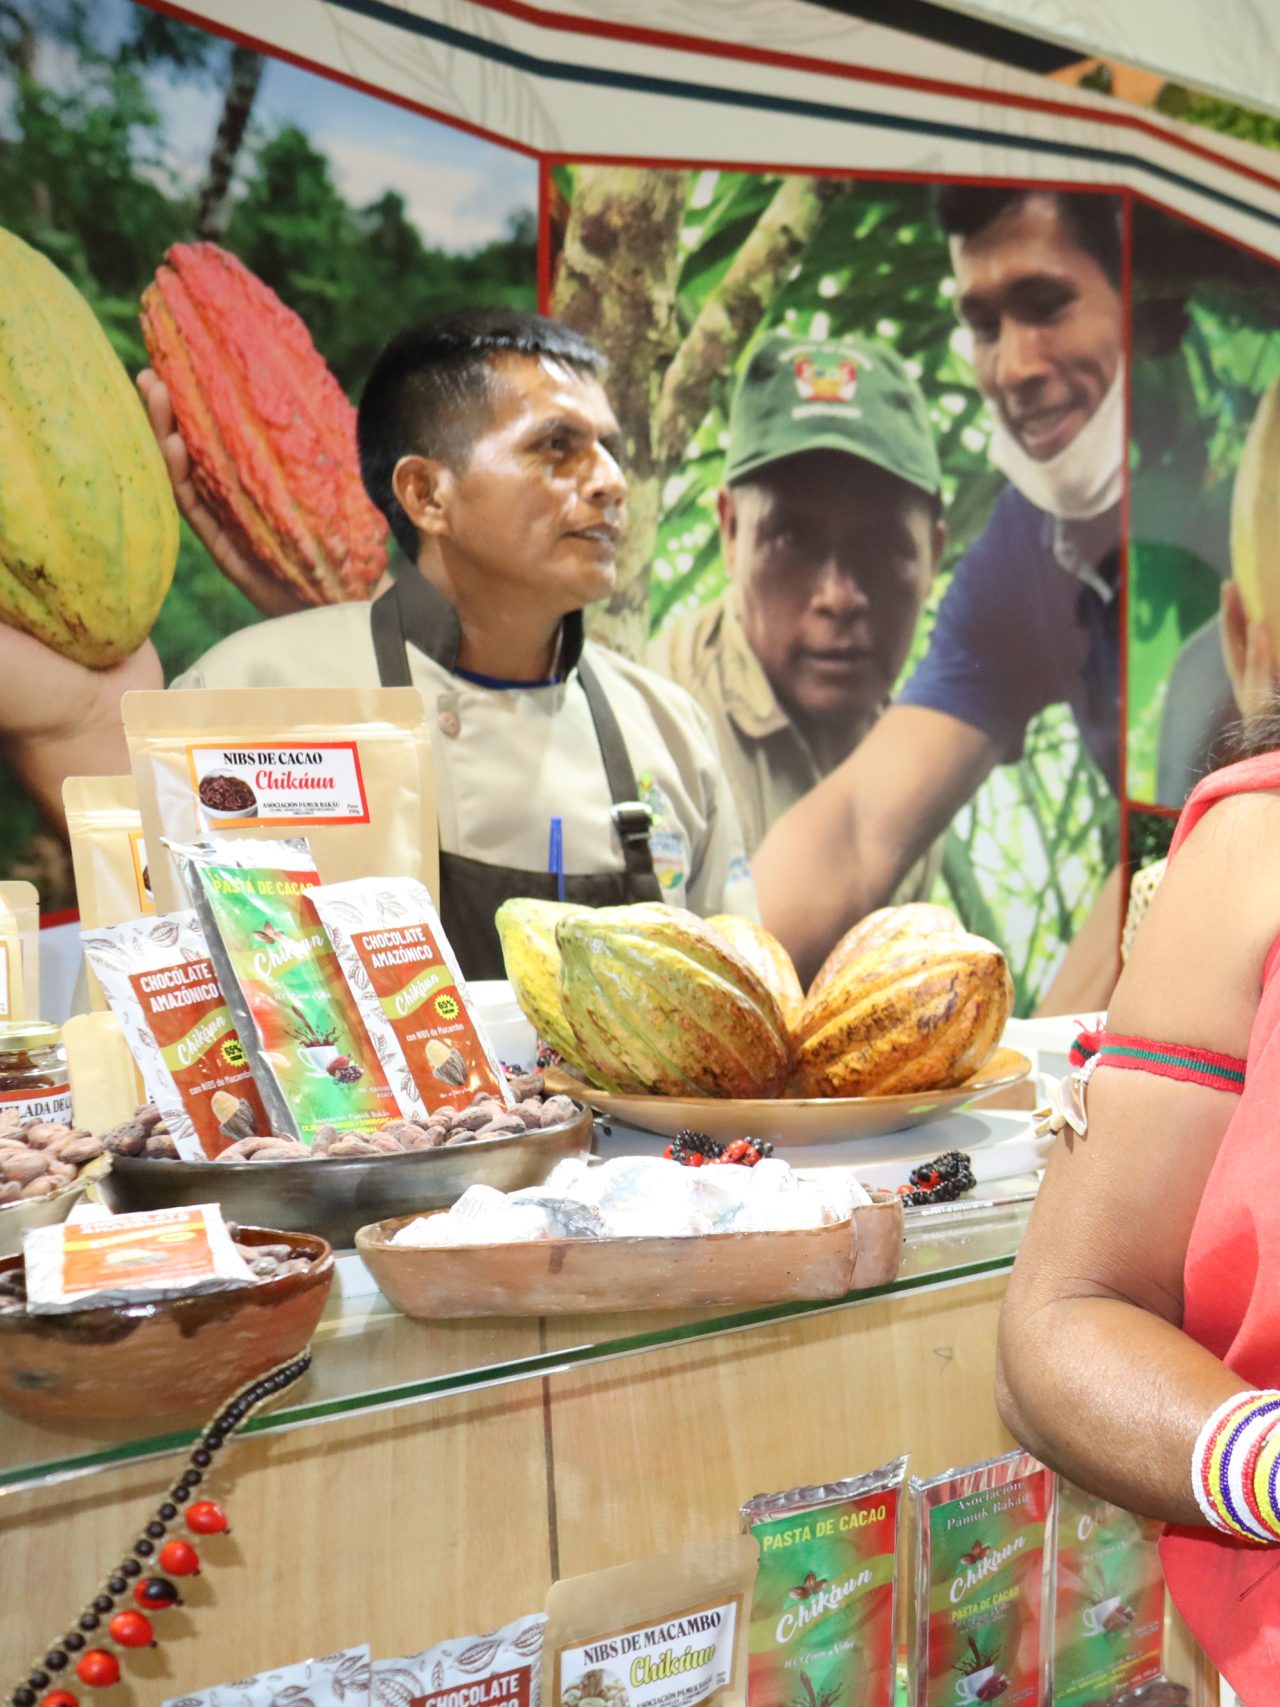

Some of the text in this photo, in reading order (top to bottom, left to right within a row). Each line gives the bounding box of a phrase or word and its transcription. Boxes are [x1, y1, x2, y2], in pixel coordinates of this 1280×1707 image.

[223, 752, 323, 765] NIBS DE CACAO
[255, 769, 335, 790] Chikáun
[257, 881, 275, 895] DE
[362, 927, 426, 950] CHOCOLATE
[371, 945, 433, 968] AMAZÓNICO
[140, 963, 211, 992] CHOCOLATE
[150, 983, 219, 1013] AMAZÓNICO
[763, 1505, 886, 1552] PASTA DE CACAO
[951, 1604, 979, 1621] PASTA
[980, 1599, 991, 1611] DE
[993, 1586, 1020, 1604] CACAO
[584, 1611, 722, 1666] NIBS DE MACAMBO
